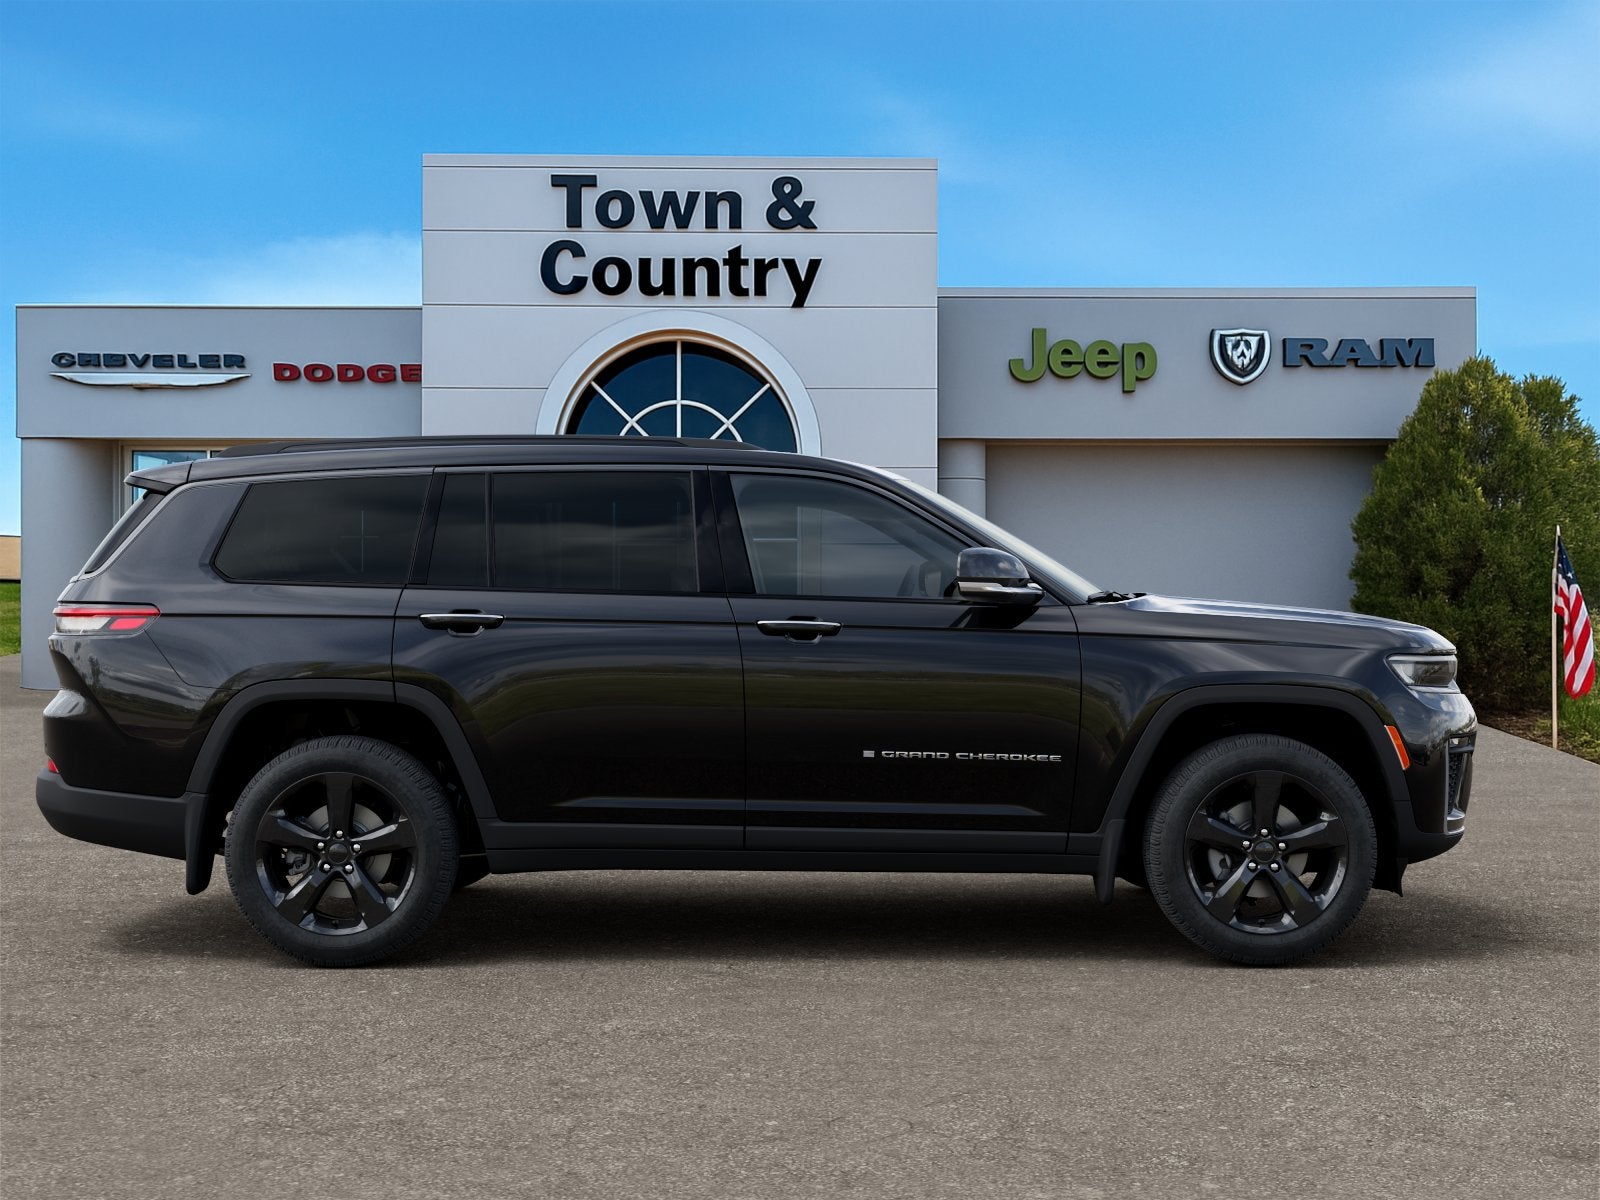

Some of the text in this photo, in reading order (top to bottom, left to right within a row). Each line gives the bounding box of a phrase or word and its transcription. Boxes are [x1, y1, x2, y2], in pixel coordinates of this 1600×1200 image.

[550, 174, 818, 230] Town &
[540, 239, 822, 308] Country
[273, 363, 422, 382] DODGE
[1009, 328, 1157, 392] Jeep
[1282, 337, 1435, 367] RAM
[881, 750, 1062, 762] GRAND CHEROKEE
